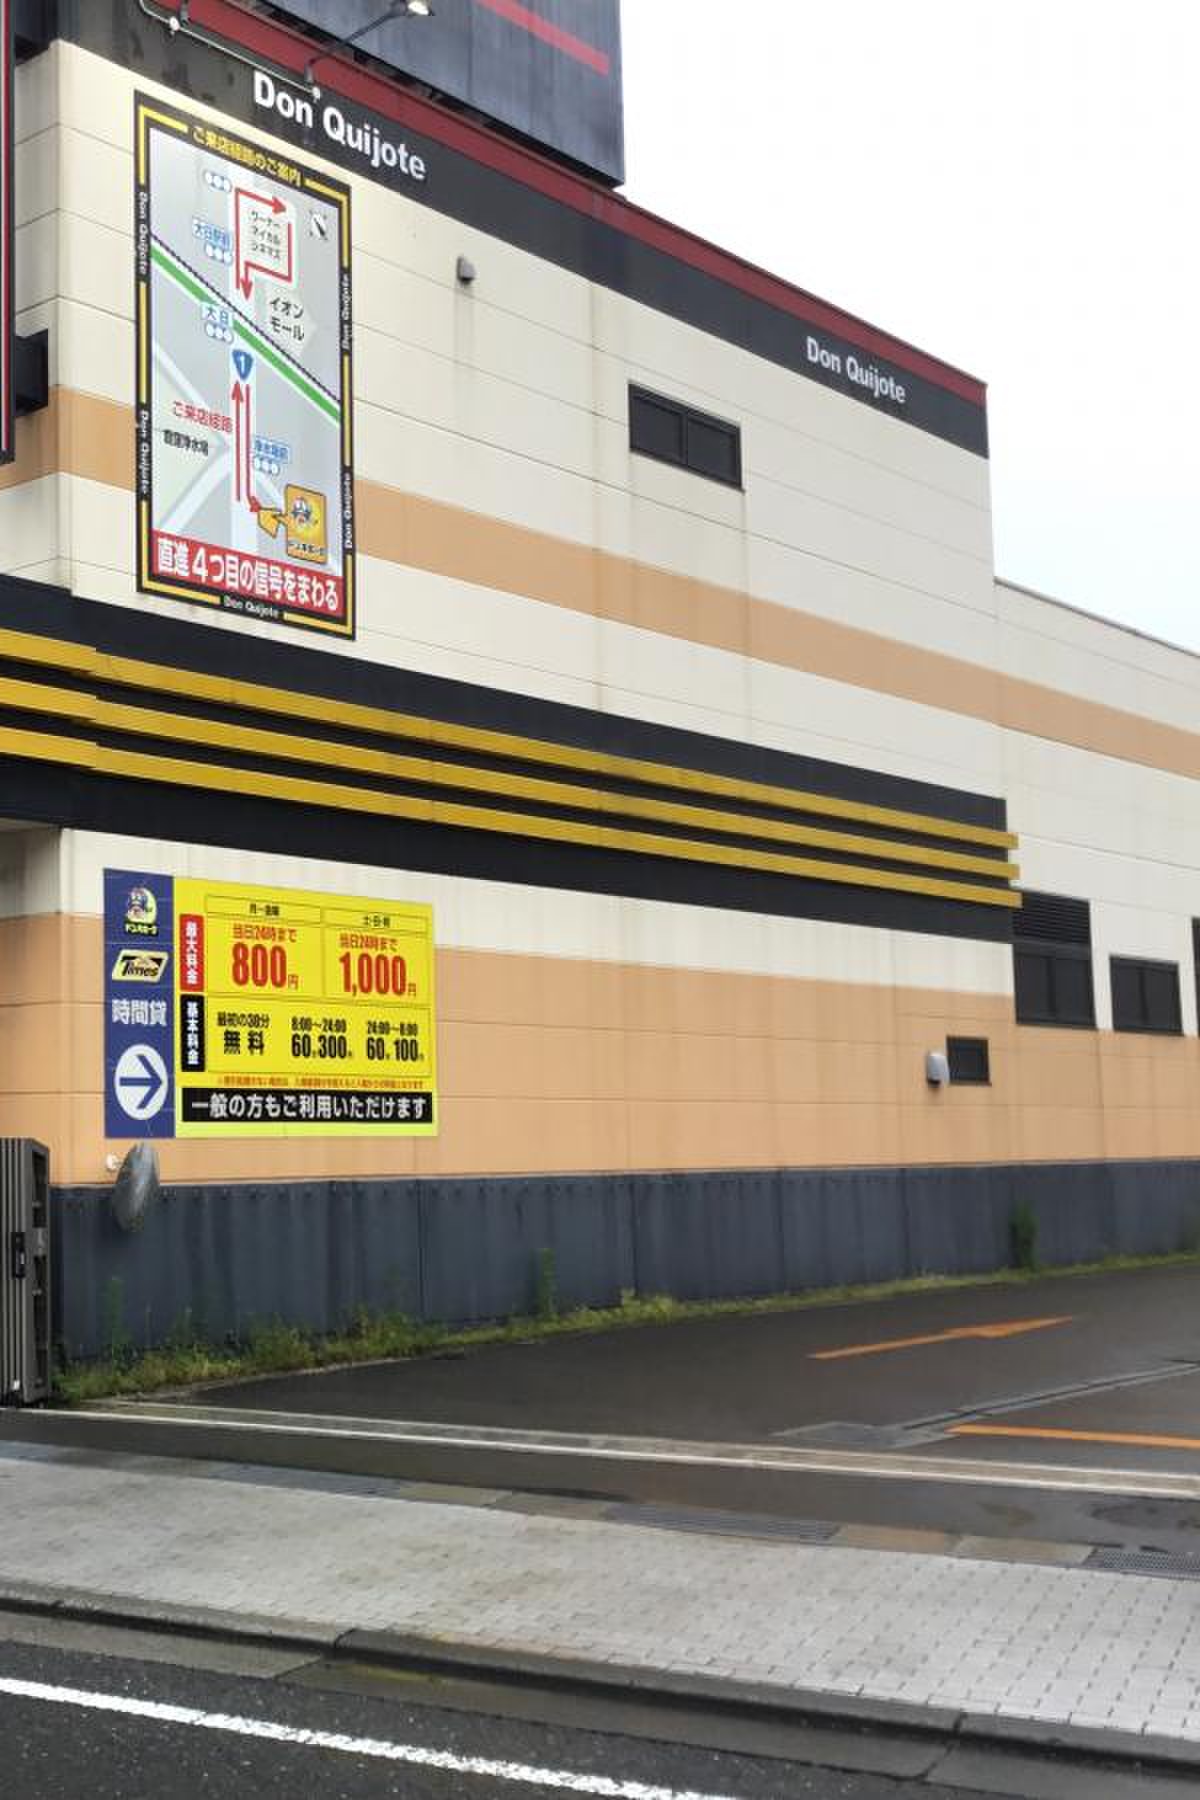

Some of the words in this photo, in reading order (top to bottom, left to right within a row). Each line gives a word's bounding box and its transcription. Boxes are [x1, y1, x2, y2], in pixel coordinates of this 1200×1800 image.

[254, 70, 313, 128] Don
[322, 107, 427, 181] Quijote
[205, 305, 230, 325] 大日
[269, 297, 305, 320] イオン
[269, 317, 305, 342] モール
[806, 335, 842, 374] Don
[845, 355, 906, 404] Quijote
[111, 998, 167, 1027] 時間貸
[191, 1091, 427, 1120] 一般の方もご利用いただけます
